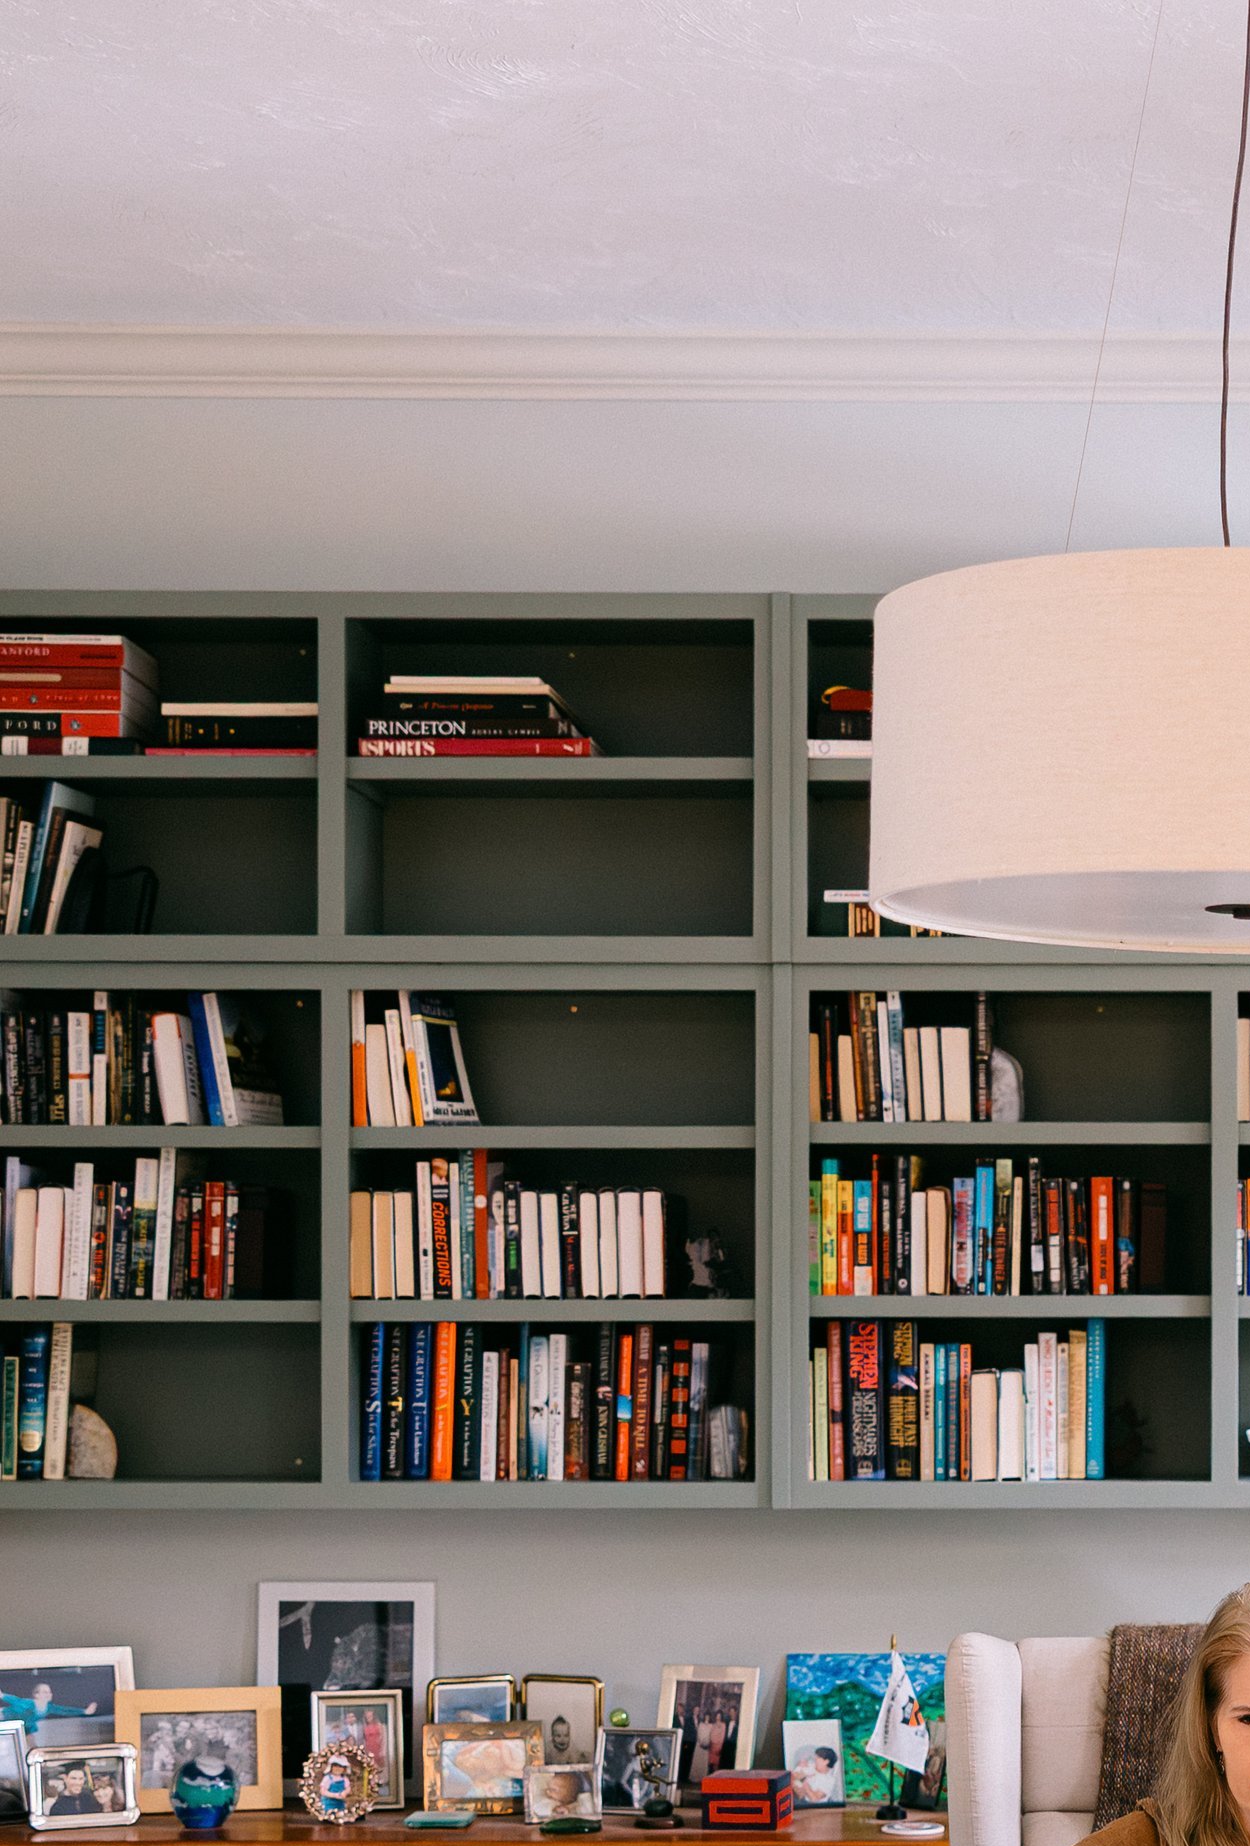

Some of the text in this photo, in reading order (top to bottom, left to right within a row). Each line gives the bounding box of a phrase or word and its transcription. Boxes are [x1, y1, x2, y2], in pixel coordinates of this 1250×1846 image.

[369, 720, 465, 735] PRINCETON
[366, 740, 436, 756] SPORTS
[432, 1201, 451, 1287] CORRECTIONS
[639, 1326, 649, 1360] GRISHAM
[849, 1335, 865, 1378] KING
[858, 1323, 879, 1389] STEPHEN
[893, 1329, 904, 1359] KING
[899, 1322, 913, 1366] STEPHEN
[388, 1396, 403, 1412] T
[637, 1378, 647, 1405] TIME
[637, 1408, 647, 1424] TO
[633, 1425, 646, 1451] KILL
